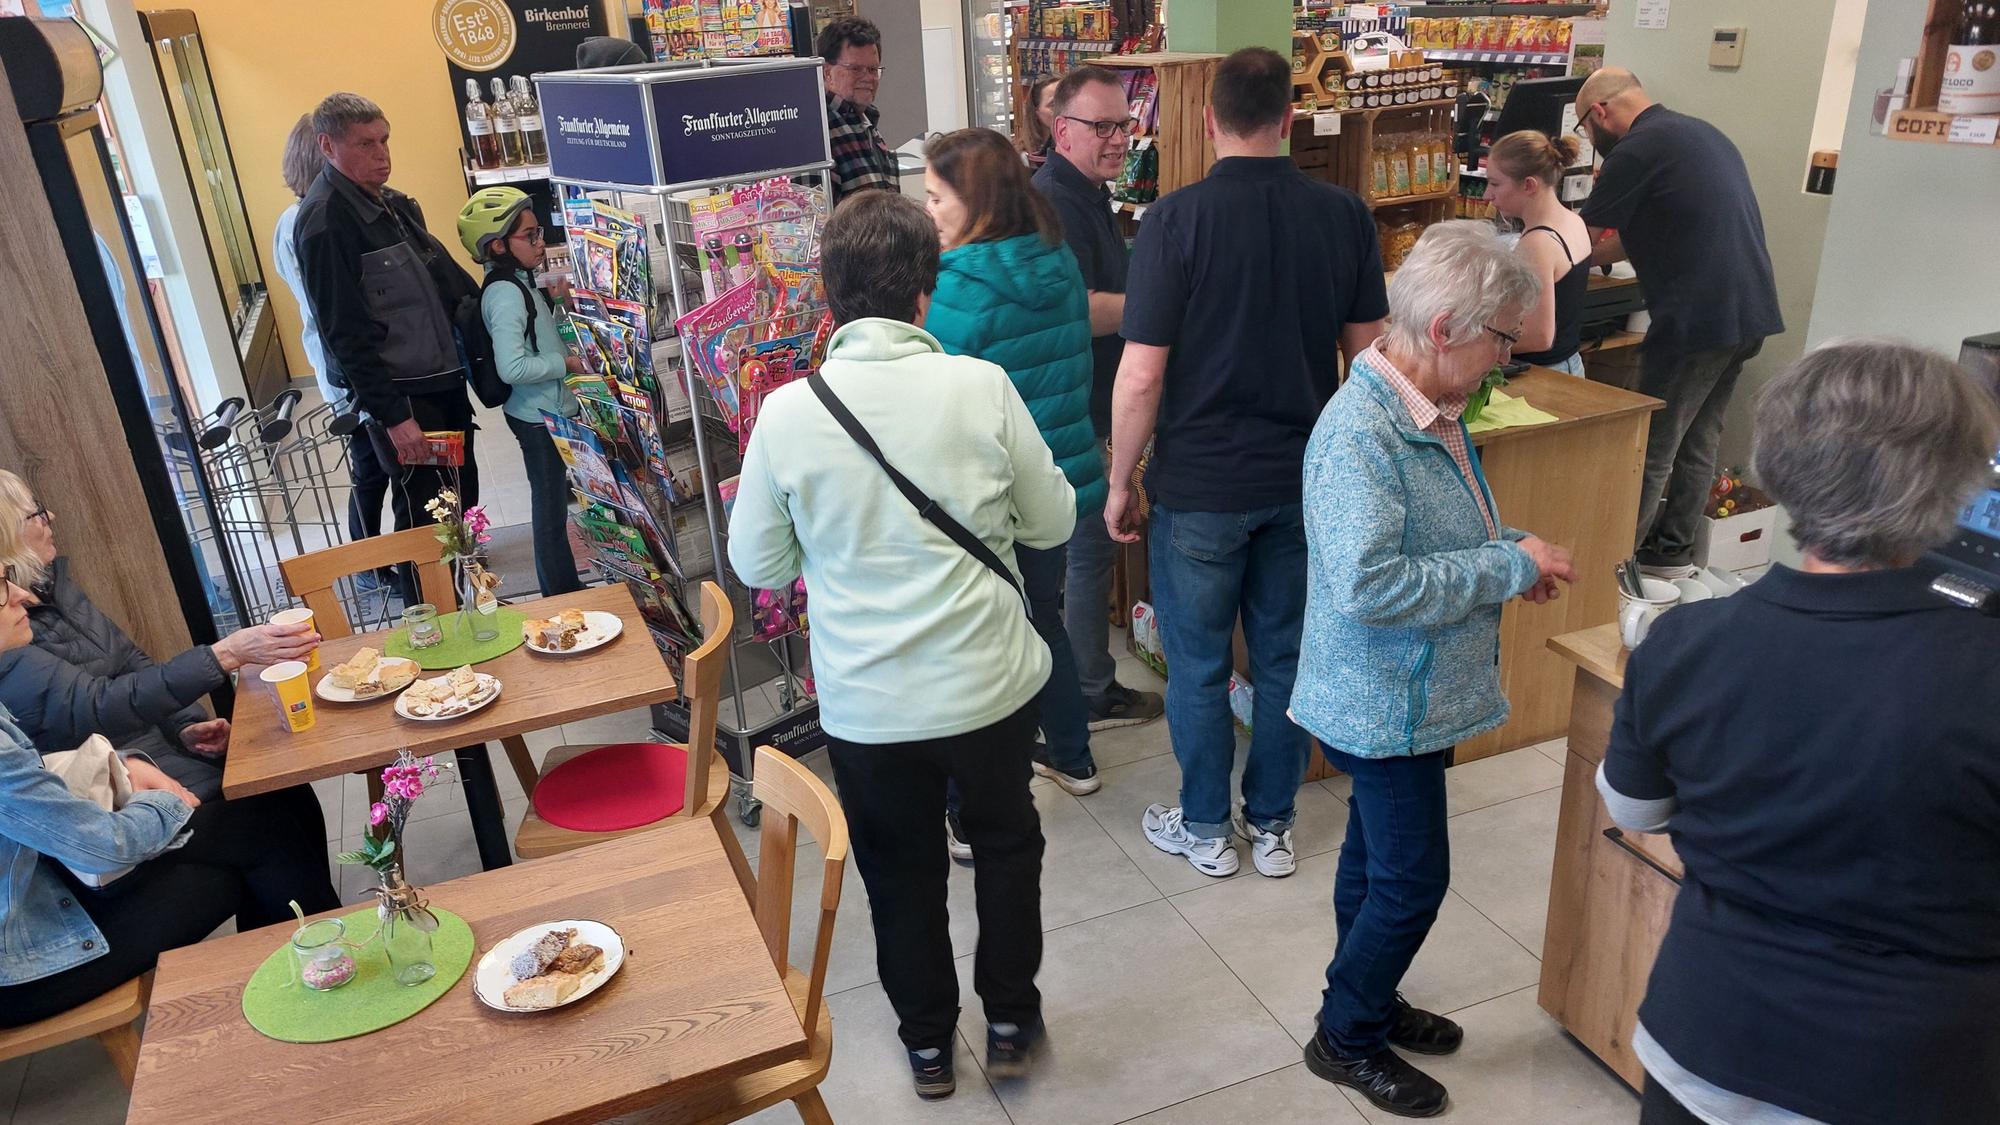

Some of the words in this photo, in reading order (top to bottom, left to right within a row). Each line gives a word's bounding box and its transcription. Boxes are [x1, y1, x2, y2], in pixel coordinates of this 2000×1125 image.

[525, 5, 589, 23] Birkenhof
[546, 19, 590, 31] Brennerei
[459, 26, 495, 47] 1848
[557, 114, 594, 136] Frankfurter
[594, 116, 631, 137] Allgemeine
[681, 110, 743, 137] Frankfurter
[744, 104, 799, 129] Allgemeine
[1896, 117, 1948, 136] COFI
[567, 137, 585, 146] ZEITUNG
[585, 138, 594, 147] FÜR
[594, 139, 627, 148] DEUTSCHLAND
[711, 126, 776, 142] SONNTAGSZEITUNG
[771, 719, 820, 747] Frankfurter
